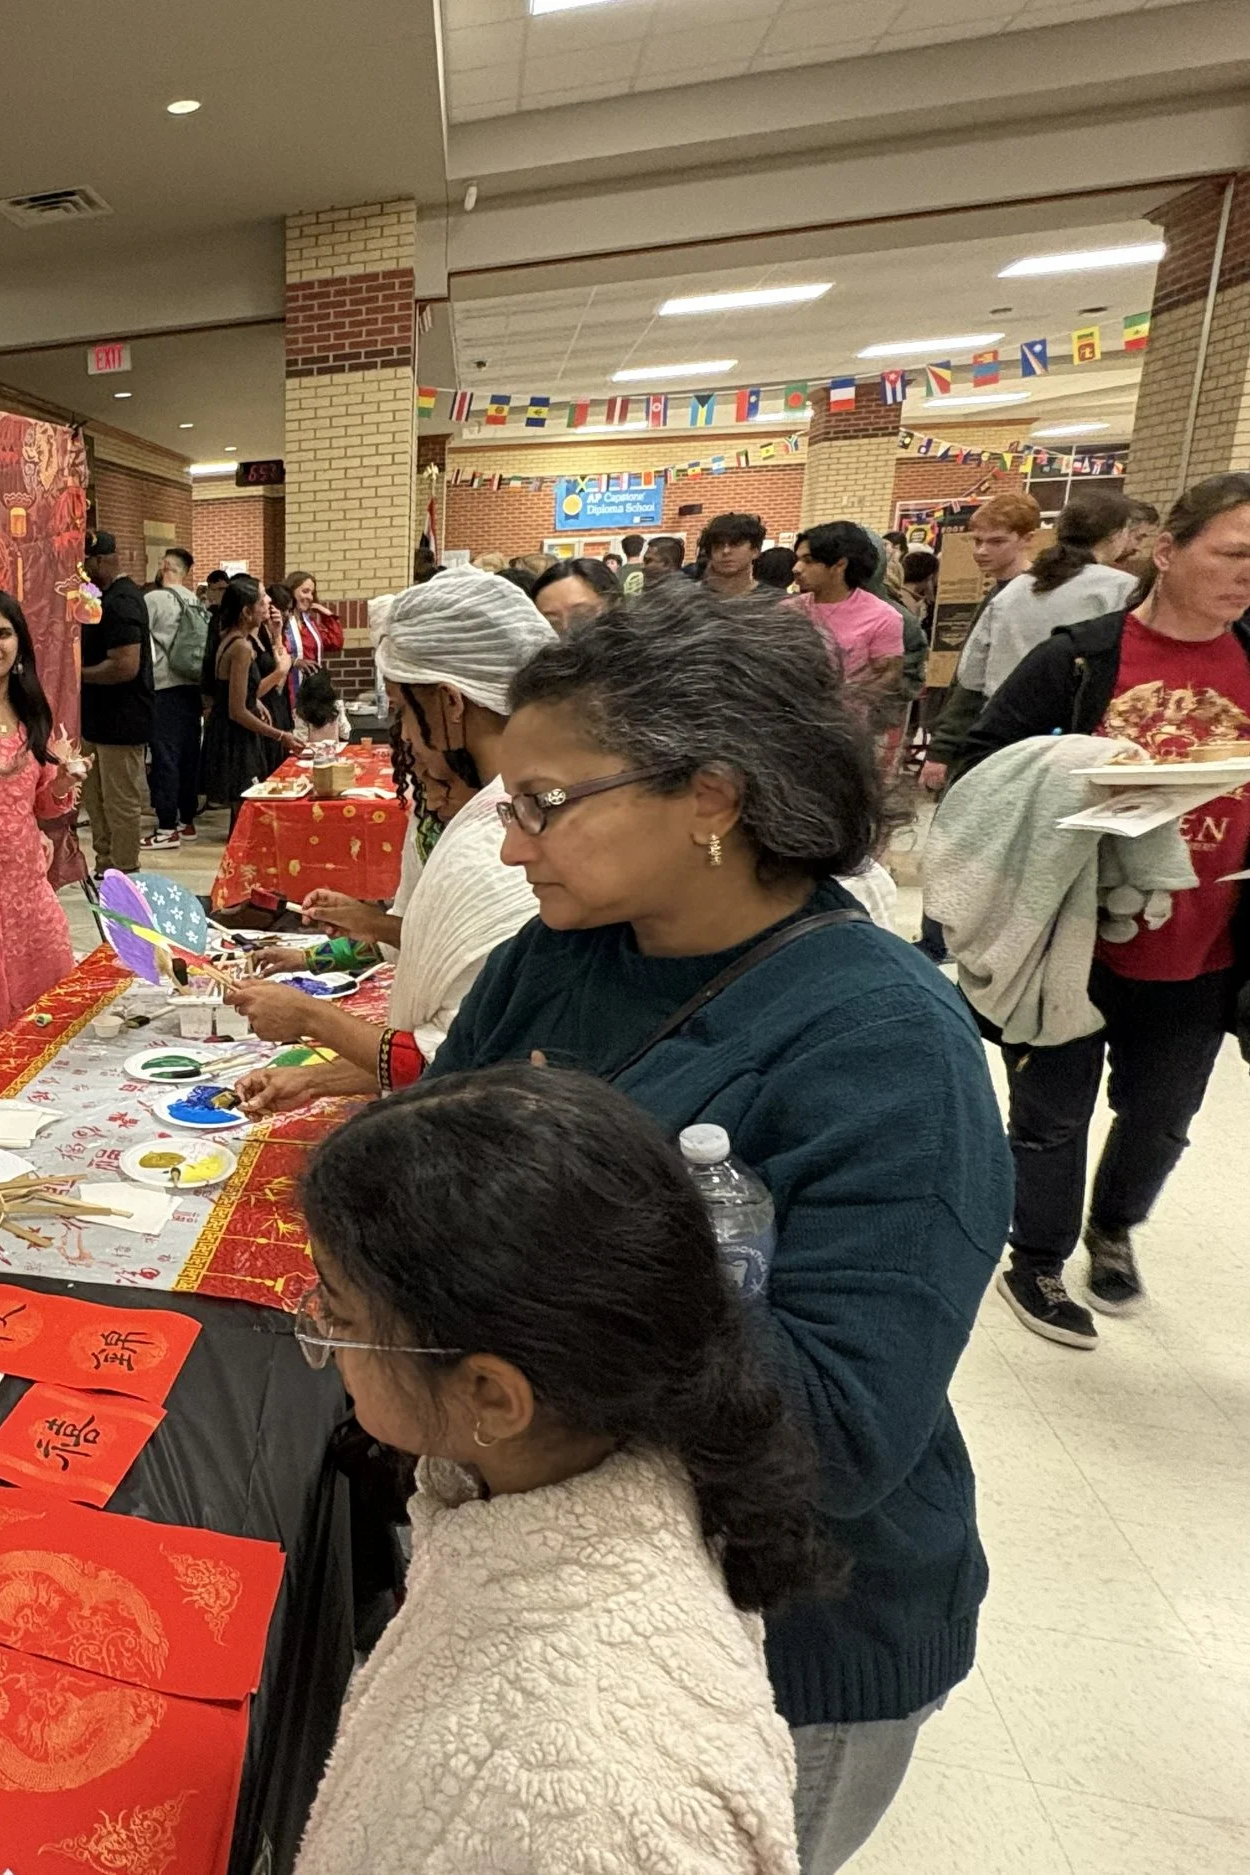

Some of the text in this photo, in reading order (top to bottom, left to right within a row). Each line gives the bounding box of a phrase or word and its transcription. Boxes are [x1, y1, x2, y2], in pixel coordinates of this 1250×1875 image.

[94, 343, 123, 371] EXIT
[586, 493, 603, 504] AP
[586, 503, 655, 516] Diploma School
